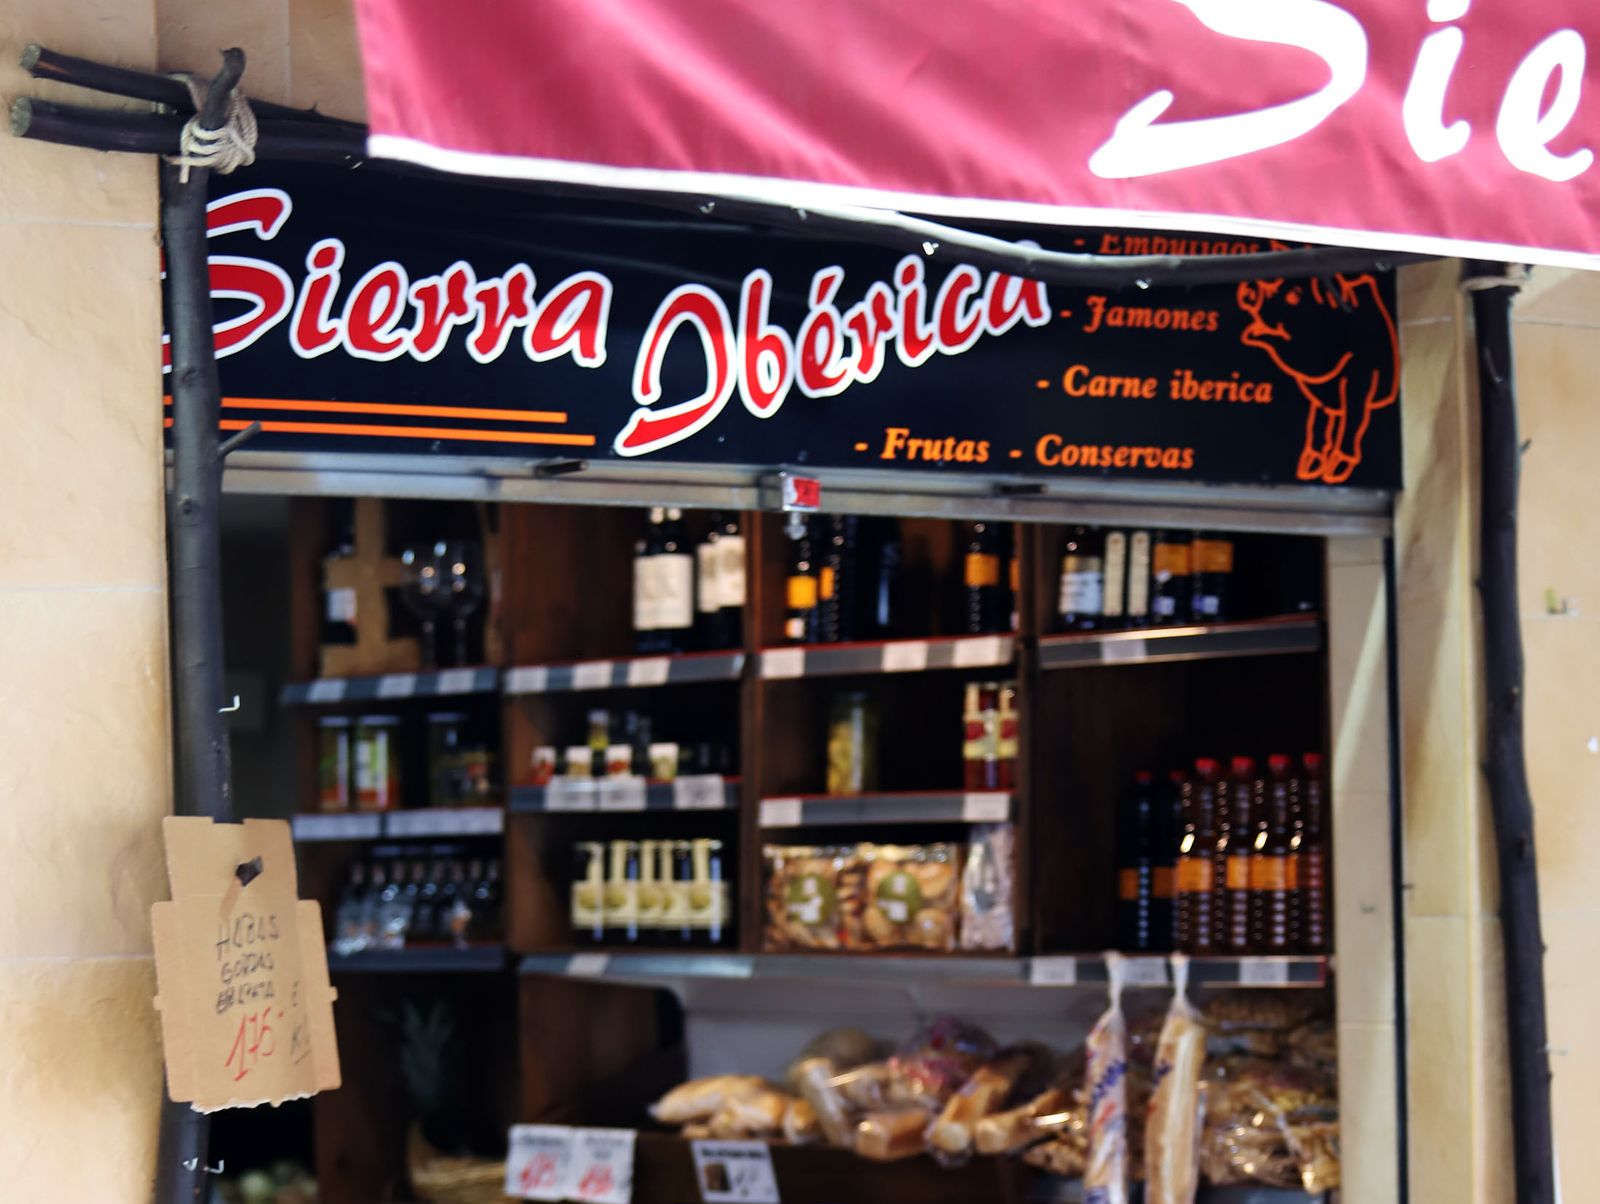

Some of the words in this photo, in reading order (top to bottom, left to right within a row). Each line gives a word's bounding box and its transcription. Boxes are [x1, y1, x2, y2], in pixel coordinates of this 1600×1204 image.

[161, 188, 611, 372] Sierra
[1082, 295, 1220, 334] Jamones
[1062, 364, 1158, 399] Carne
[1169, 369, 1273, 404] iberica
[880, 427, 990, 462] Frutas
[1035, 433, 1195, 469] Conservas
